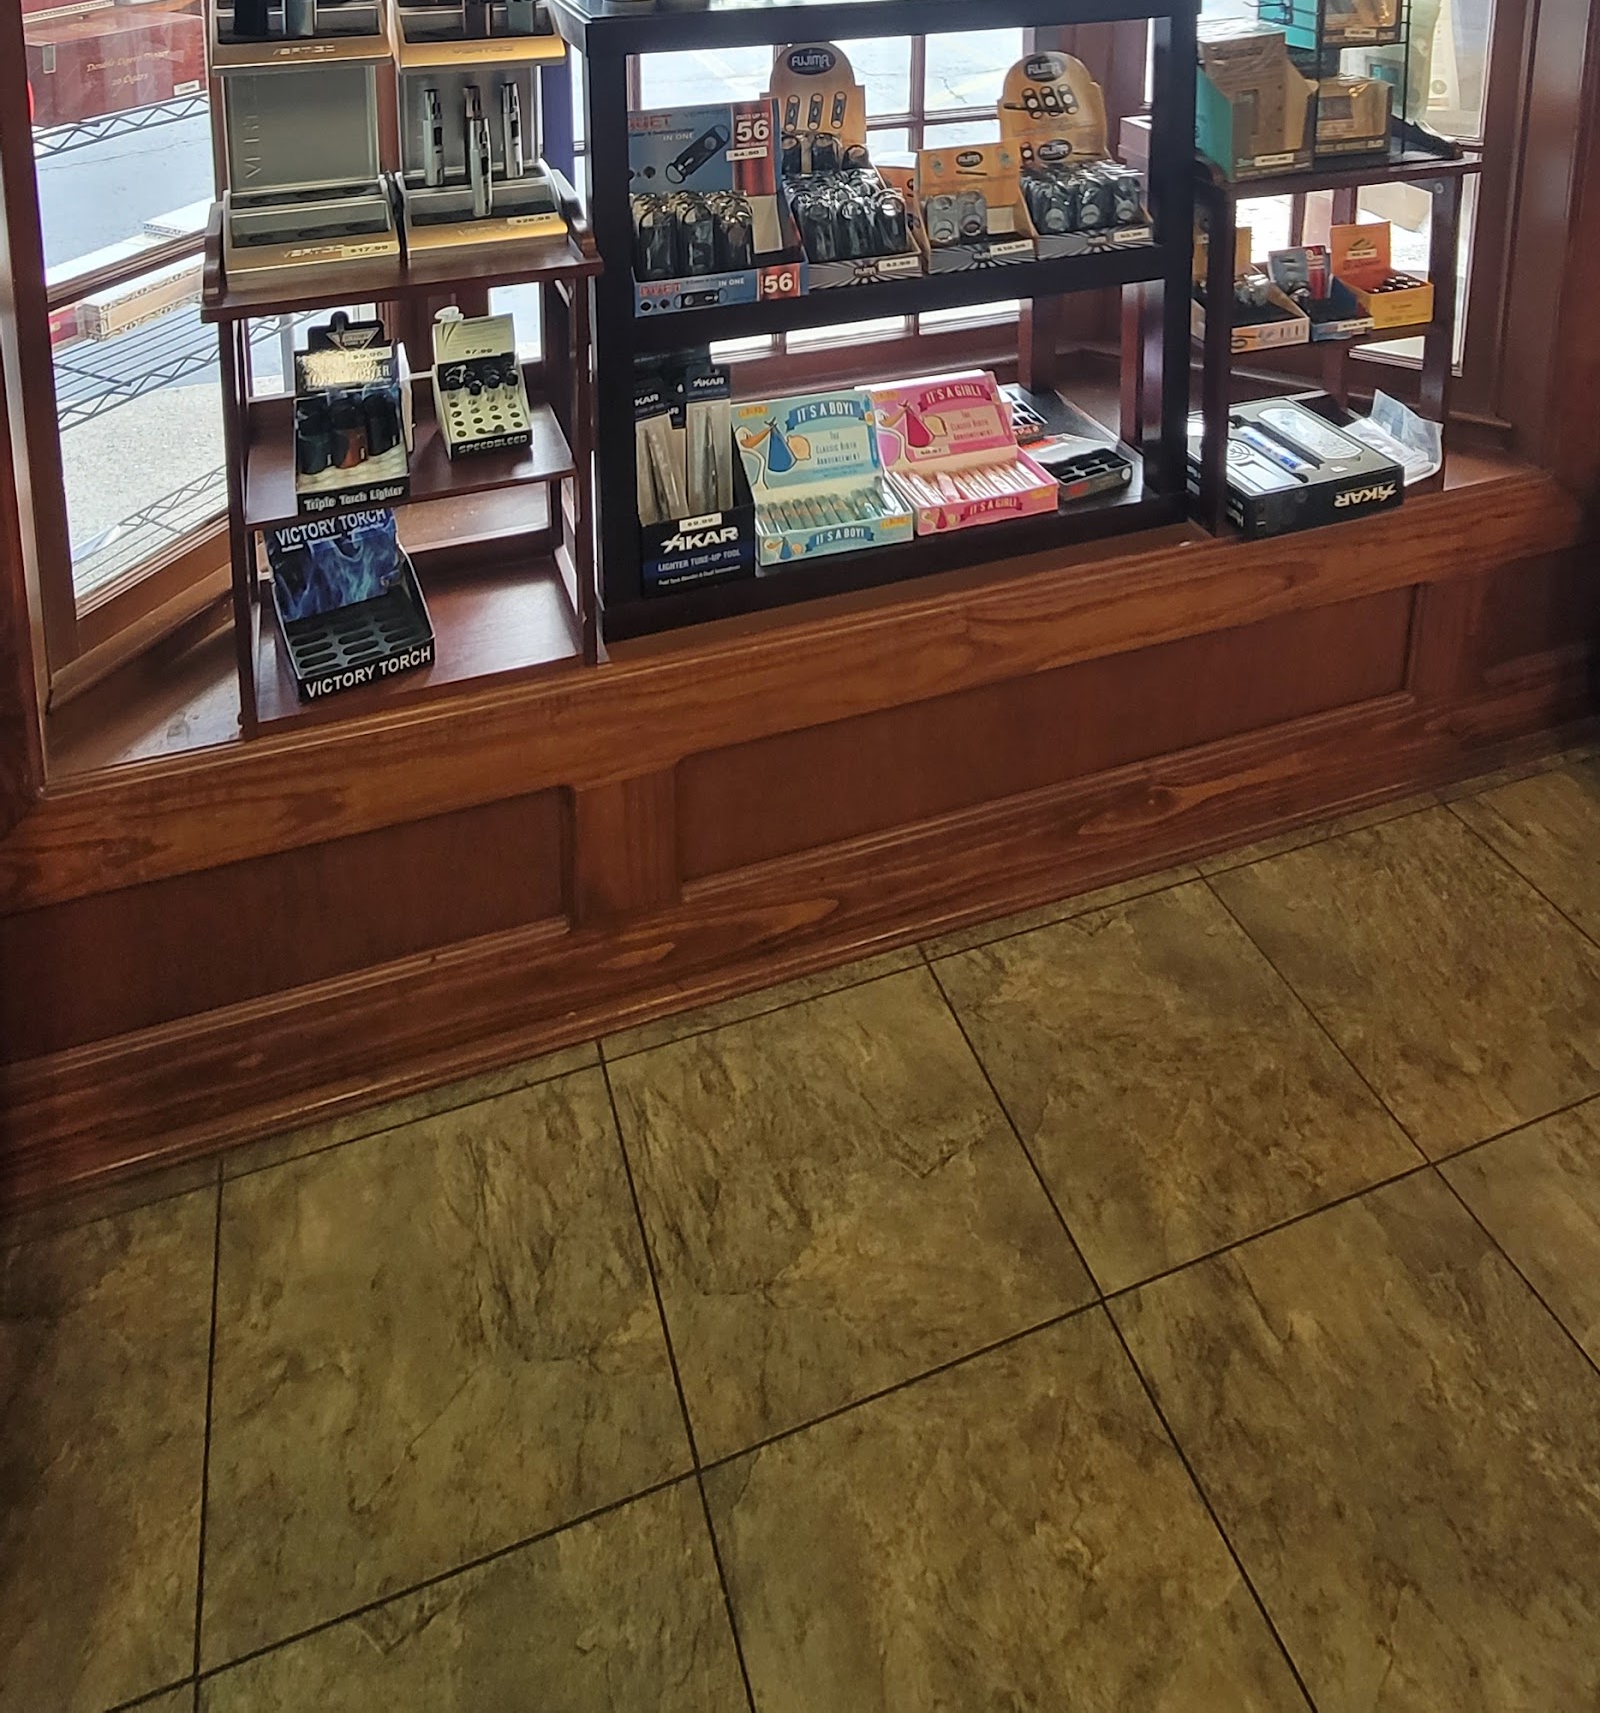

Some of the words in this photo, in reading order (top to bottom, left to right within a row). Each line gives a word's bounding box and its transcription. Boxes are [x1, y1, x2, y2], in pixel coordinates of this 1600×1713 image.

[791, 54, 831, 67] FUJIMA
[676, 132, 694, 140] ONE
[736, 119, 769, 142] 56
[639, 283, 681, 297] DUET
[764, 272, 793, 294] 56
[693, 377, 724, 387] XIKAR
[926, 388, 945, 403] IT'S
[947, 388, 952, 399] A
[955, 385, 981, 397] GIRL!
[797, 402, 817, 423] IT'S
[820, 402, 828, 416] A
[829, 401, 854, 416] BOY!
[304, 497, 336, 511] Triple
[339, 492, 367, 506] Torch
[369, 486, 404, 501] Lighter
[275, 517, 336, 546] VICTORY
[339, 508, 386, 530] TORCH
[835, 530, 842, 540] A
[844, 527, 864, 538] BOY!
[660, 526, 739, 554] XIKAR
[658, 559, 689, 572] LIGHTER
[690, 552, 722, 566] TUNE-UP
[723, 548, 741, 559] TOOL
[305, 664, 375, 698] VICTORY
[379, 645, 431, 676] TORCH
